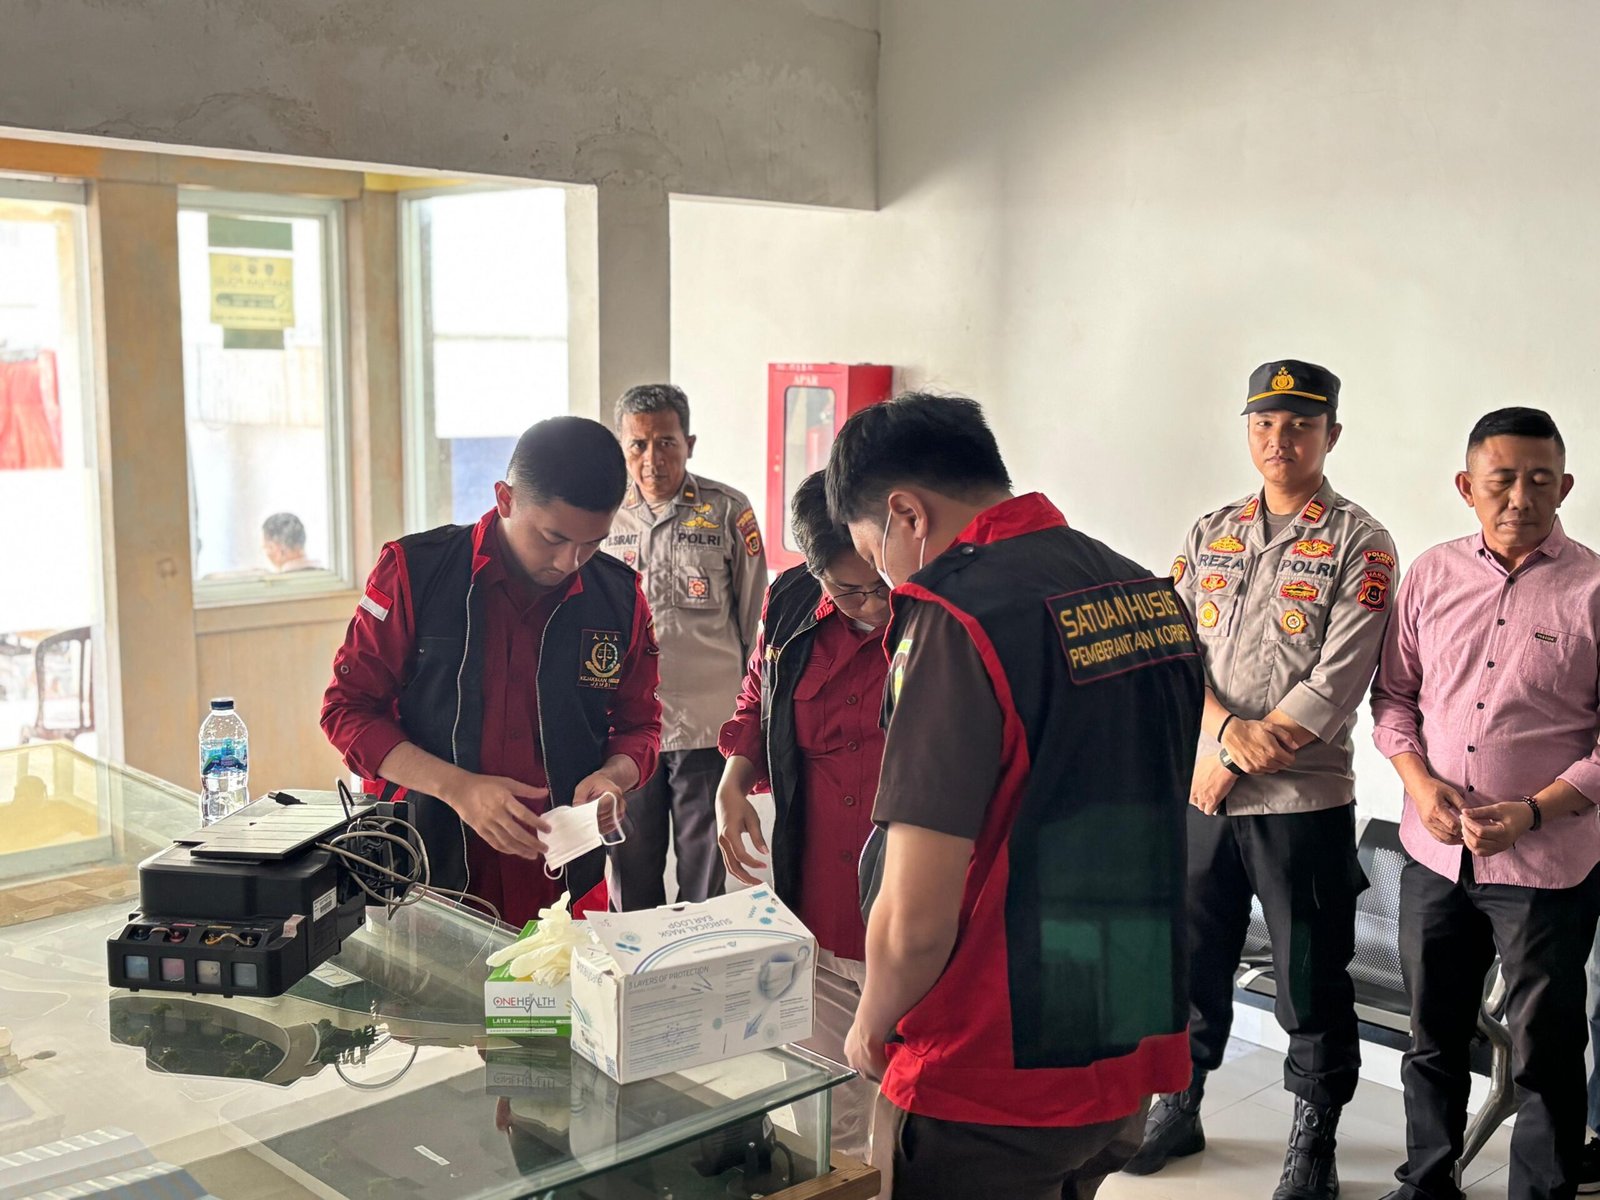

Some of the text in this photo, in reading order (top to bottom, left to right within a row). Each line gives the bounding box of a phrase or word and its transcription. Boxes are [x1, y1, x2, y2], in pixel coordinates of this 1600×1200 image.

[678, 532, 720, 546] POLRI
[1199, 553, 1245, 570] REZA
[1279, 559, 1337, 578] POLRI
[1060, 595, 1132, 638] SATUAN
[1069, 630, 1156, 669] PEMBERANTAN
[658, 918, 733, 938] SURGICAL MASK
[668, 914, 714, 930] EAR LOOP
[633, 977, 657, 988] LAYERS
[659, 974, 668, 983] OF
[669, 965, 710, 980] PROTECTION
